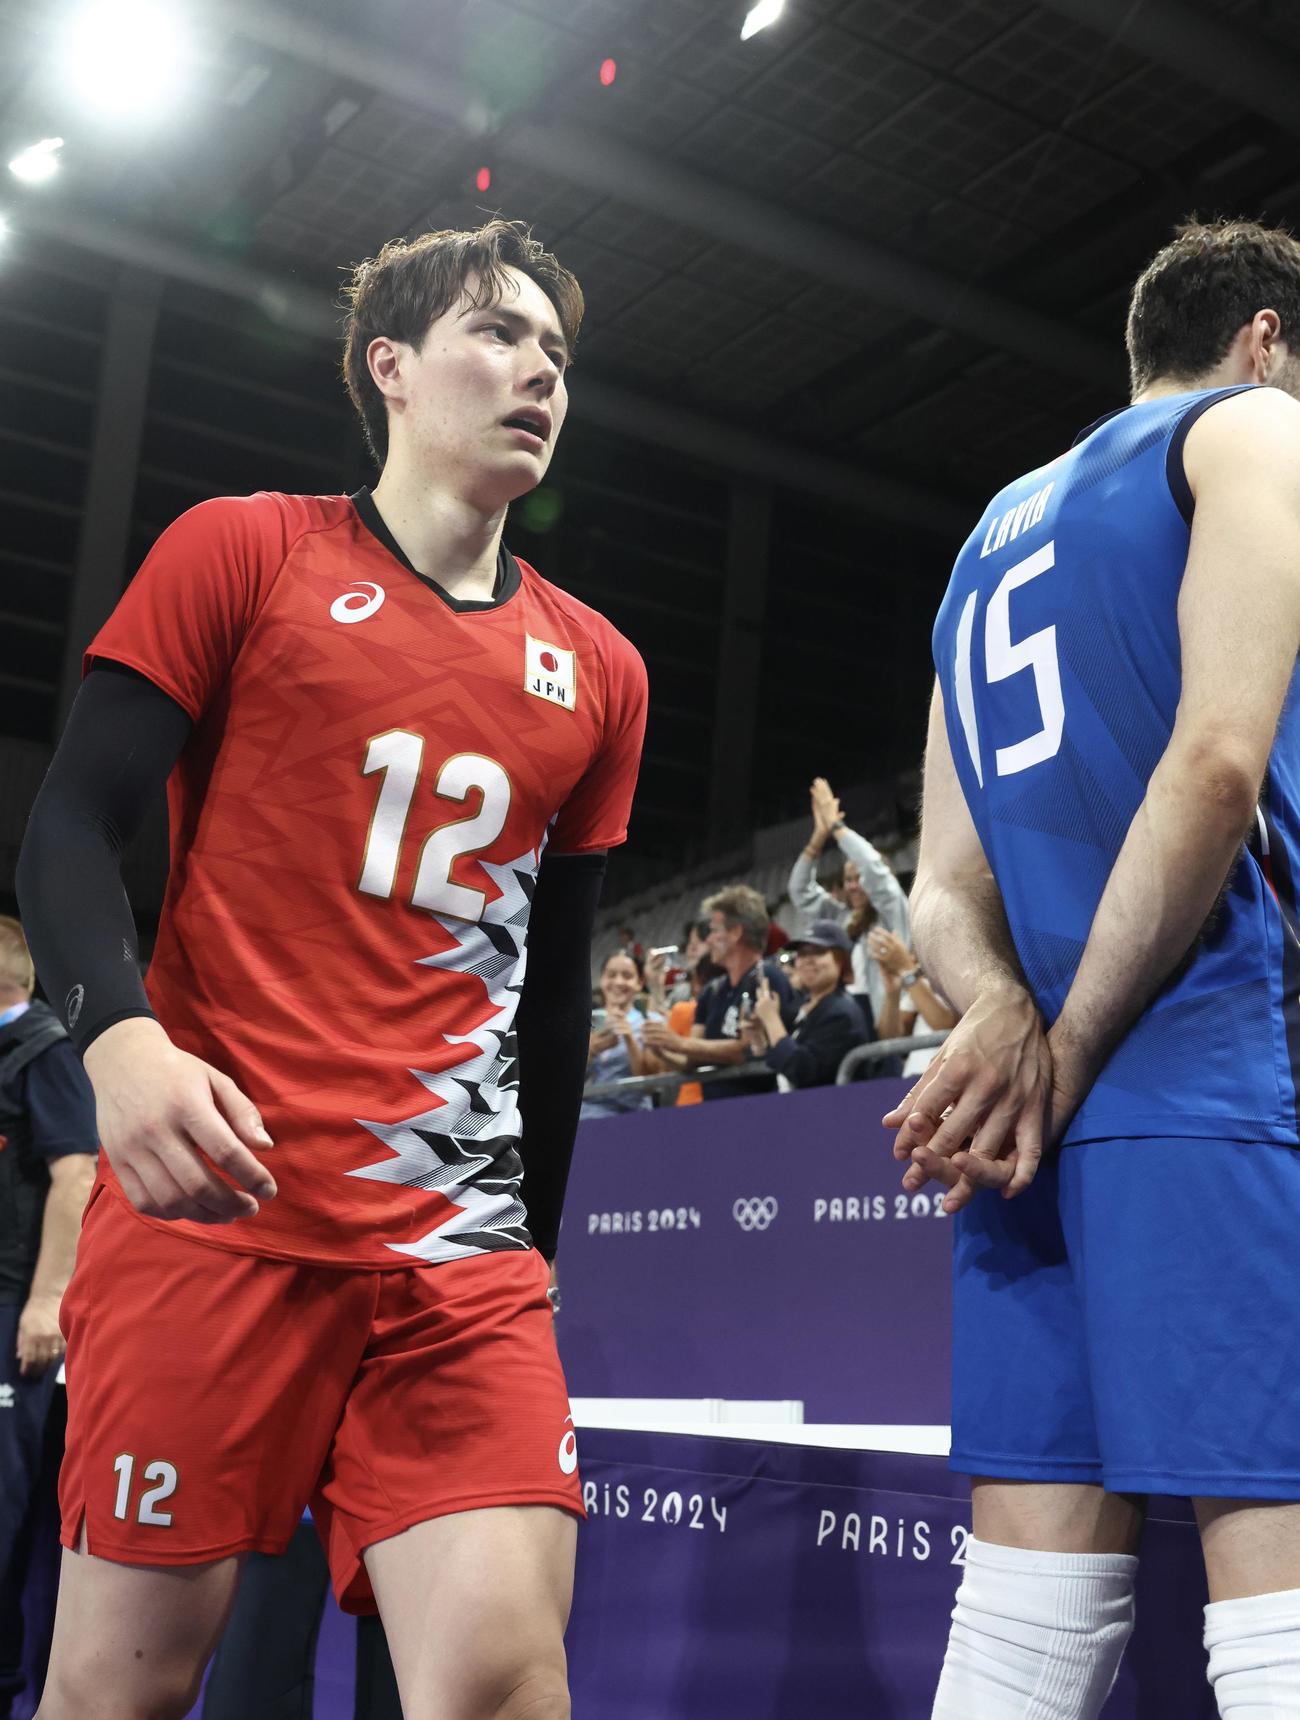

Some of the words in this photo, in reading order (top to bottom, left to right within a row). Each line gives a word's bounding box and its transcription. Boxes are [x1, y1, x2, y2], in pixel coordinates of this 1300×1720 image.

[979, 480, 1056, 560] LAVIA
[532, 678, 566, 703] JPN
[954, 539, 1066, 790] 15
[356, 727, 512, 924] 12
[647, 1205, 701, 1232] 2024
[894, 1191, 948, 1219] 202
[112, 1450, 180, 1528] 12
[641, 1487, 727, 1533] 2024
